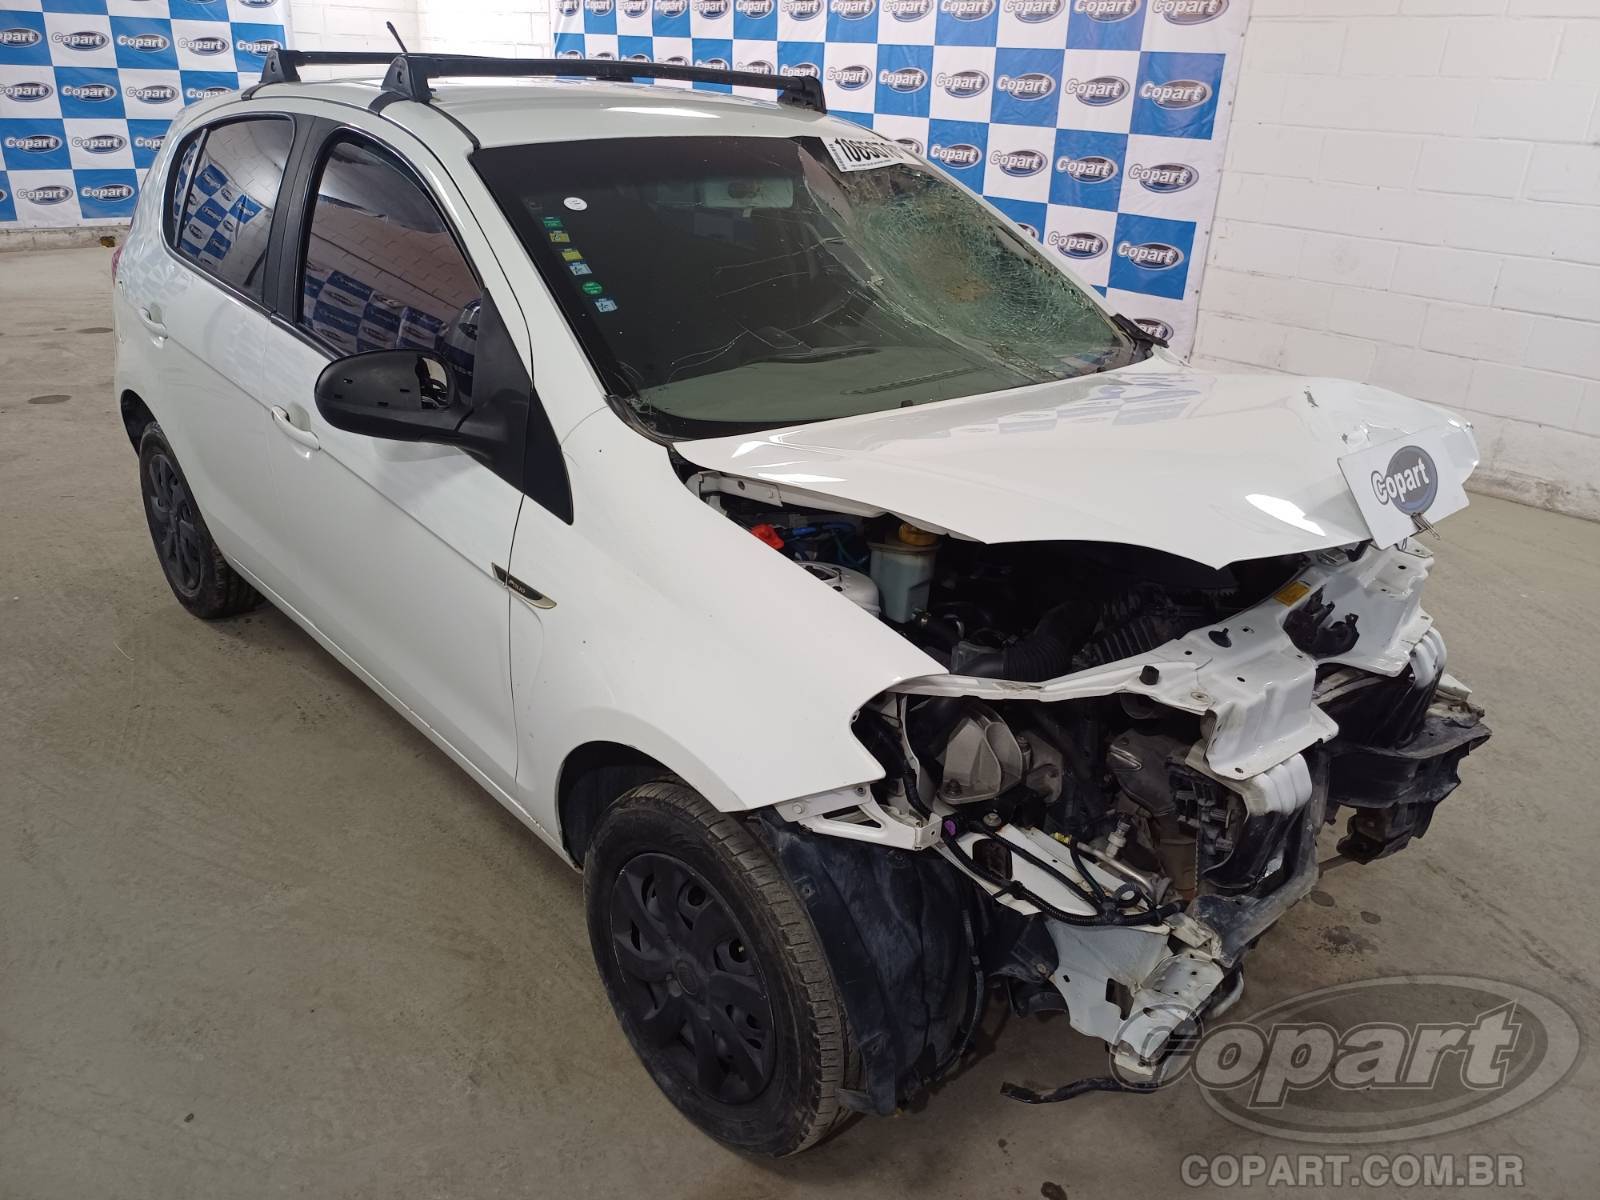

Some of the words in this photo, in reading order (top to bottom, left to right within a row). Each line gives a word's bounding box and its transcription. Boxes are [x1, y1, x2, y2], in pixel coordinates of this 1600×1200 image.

[693, 0, 725, 13] Copart
[736, 0, 771, 14] Copart
[781, 0, 818, 15] Copart
[831, 0, 870, 15] Copart
[884, 0, 926, 16] Copart
[941, 0, 989, 17] Copart
[1004, 0, 1057, 17] Copart
[1074, 0, 1133, 17] Copart
[1152, 0, 1217, 18] Copart
[53, 32, 102, 46] Copart
[118, 36, 165, 48] Copart
[180, 38, 222, 50] Copart
[237, 41, 277, 52] Copart
[827, 67, 867, 86] Copart
[879, 70, 923, 88] Copart
[936, 73, 983, 91] Copart
[63, 86, 110, 98] Copart
[126, 87, 171, 100] Copart
[997, 76, 1049, 95] Copart
[1065, 79, 1121, 99] Copart
[1141, 82, 1203, 104] Copart
[5, 137, 56, 149] Copart
[72, 137, 121, 150] Copart
[930, 144, 978, 164] Copart
[990, 150, 1041, 170] Copart
[1056, 155, 1112, 178] Copart
[1129, 164, 1189, 186] Copart
[17, 189, 66, 201] Copart
[81, 187, 129, 199] Copart
[1048, 231, 1101, 252] Copart
[1118, 241, 1176, 265] Copart
[1371, 457, 1430, 505] Copart
